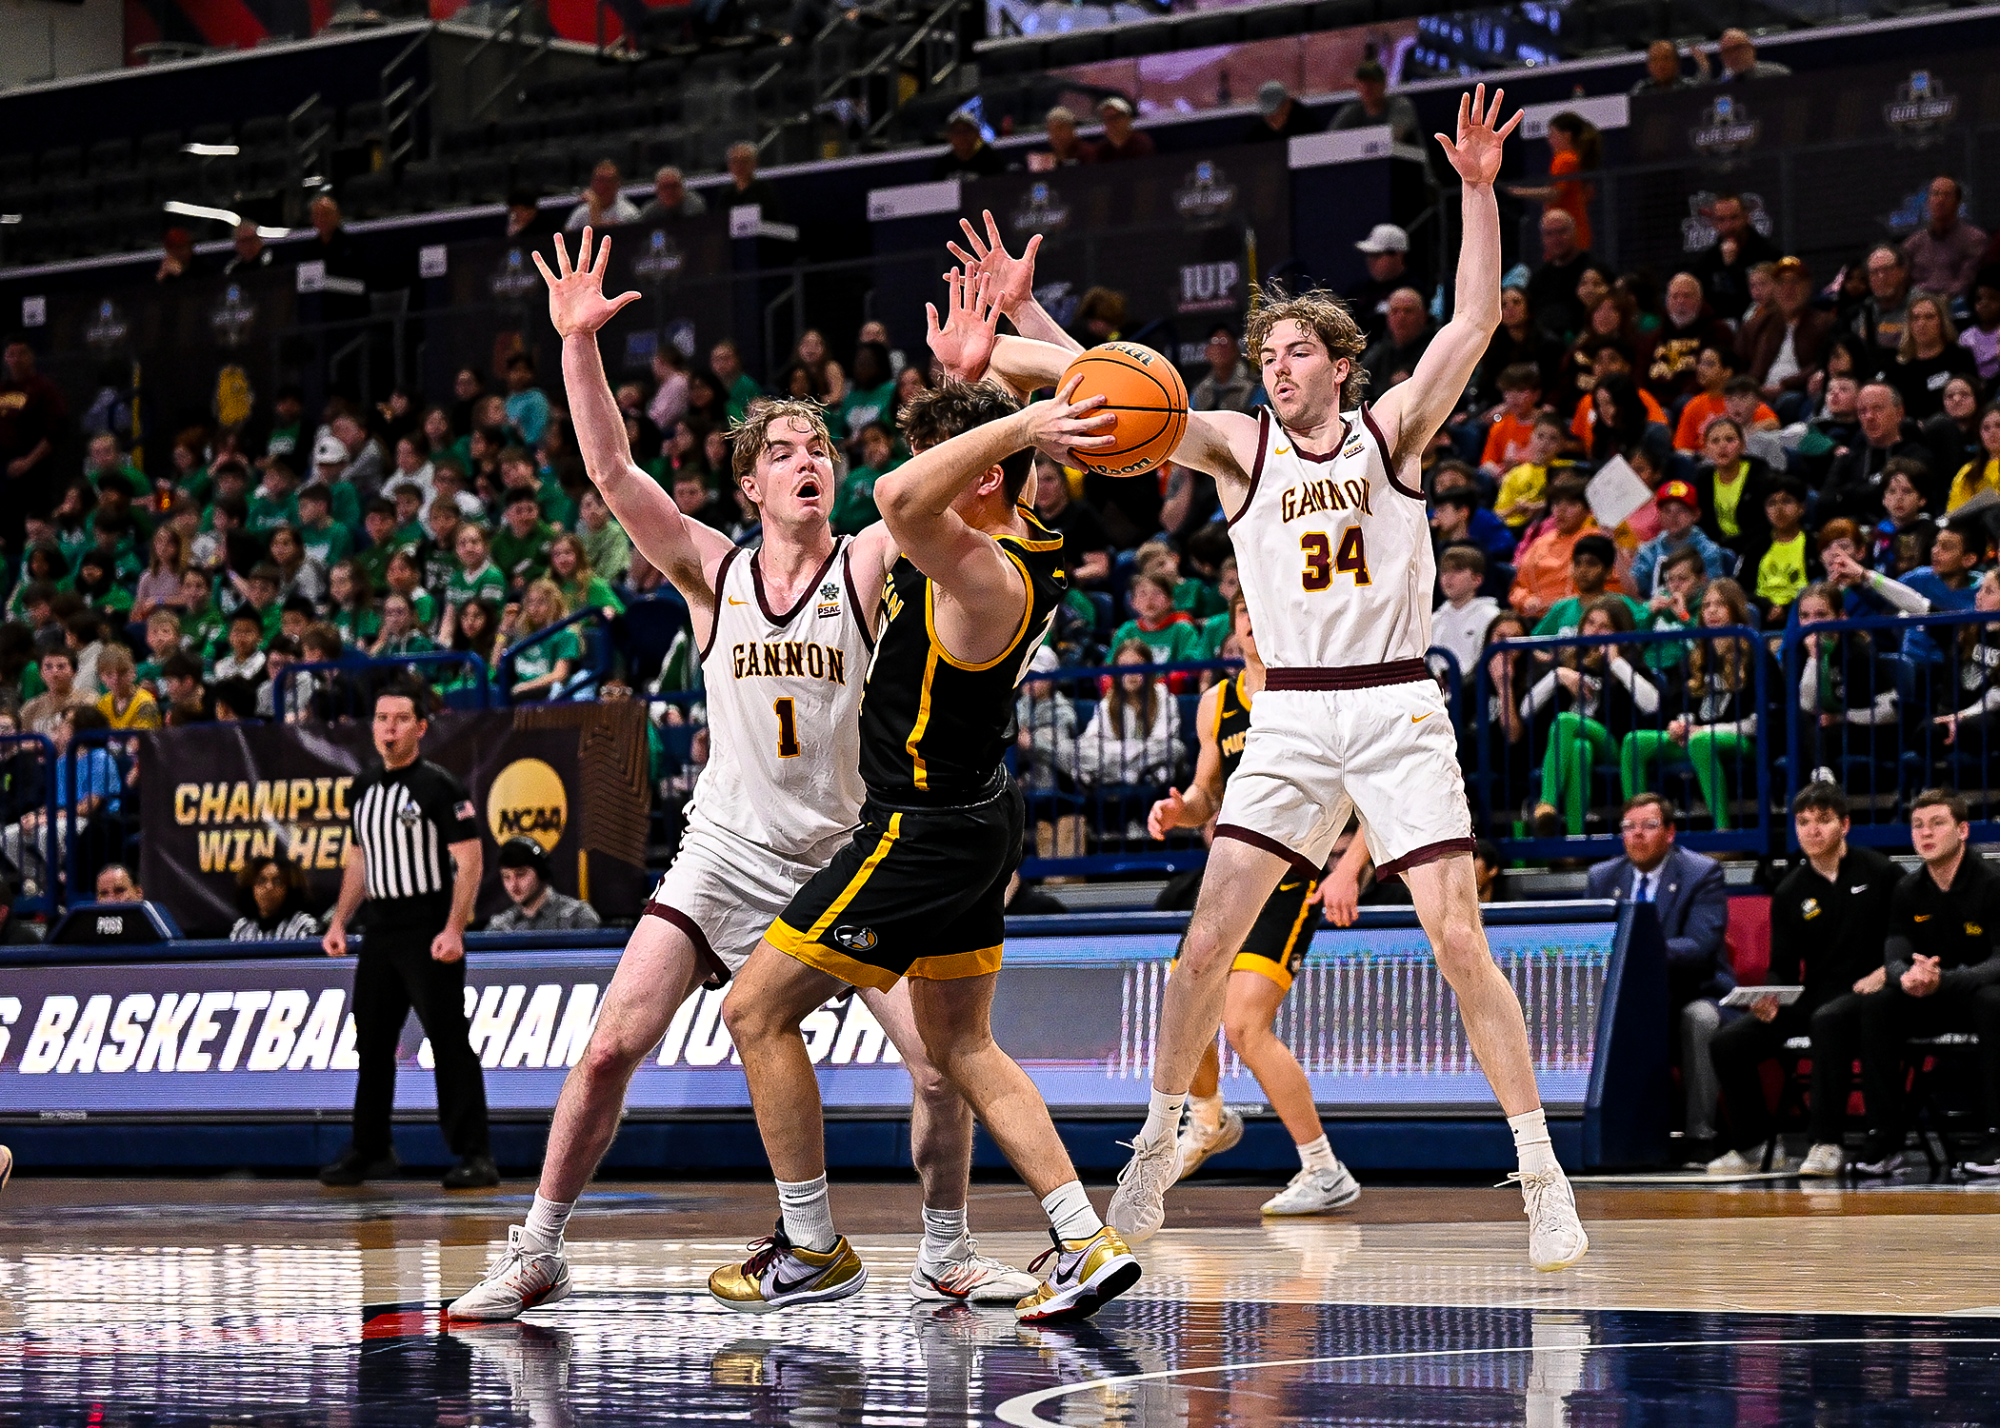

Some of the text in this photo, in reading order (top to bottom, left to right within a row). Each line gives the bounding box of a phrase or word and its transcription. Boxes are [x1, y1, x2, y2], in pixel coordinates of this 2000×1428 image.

[1180, 261, 1238, 299] IUP
[1282, 477, 1373, 524] GANNON
[1299, 525, 1372, 592] 34
[817, 605, 841, 615] PSAC
[732, 640, 846, 687] GANNON
[773, 697, 801, 758] 1
[498, 807, 562, 834] NCAA
[198, 829, 276, 872] WIN
[18, 989, 359, 1073] BASKETBAL
